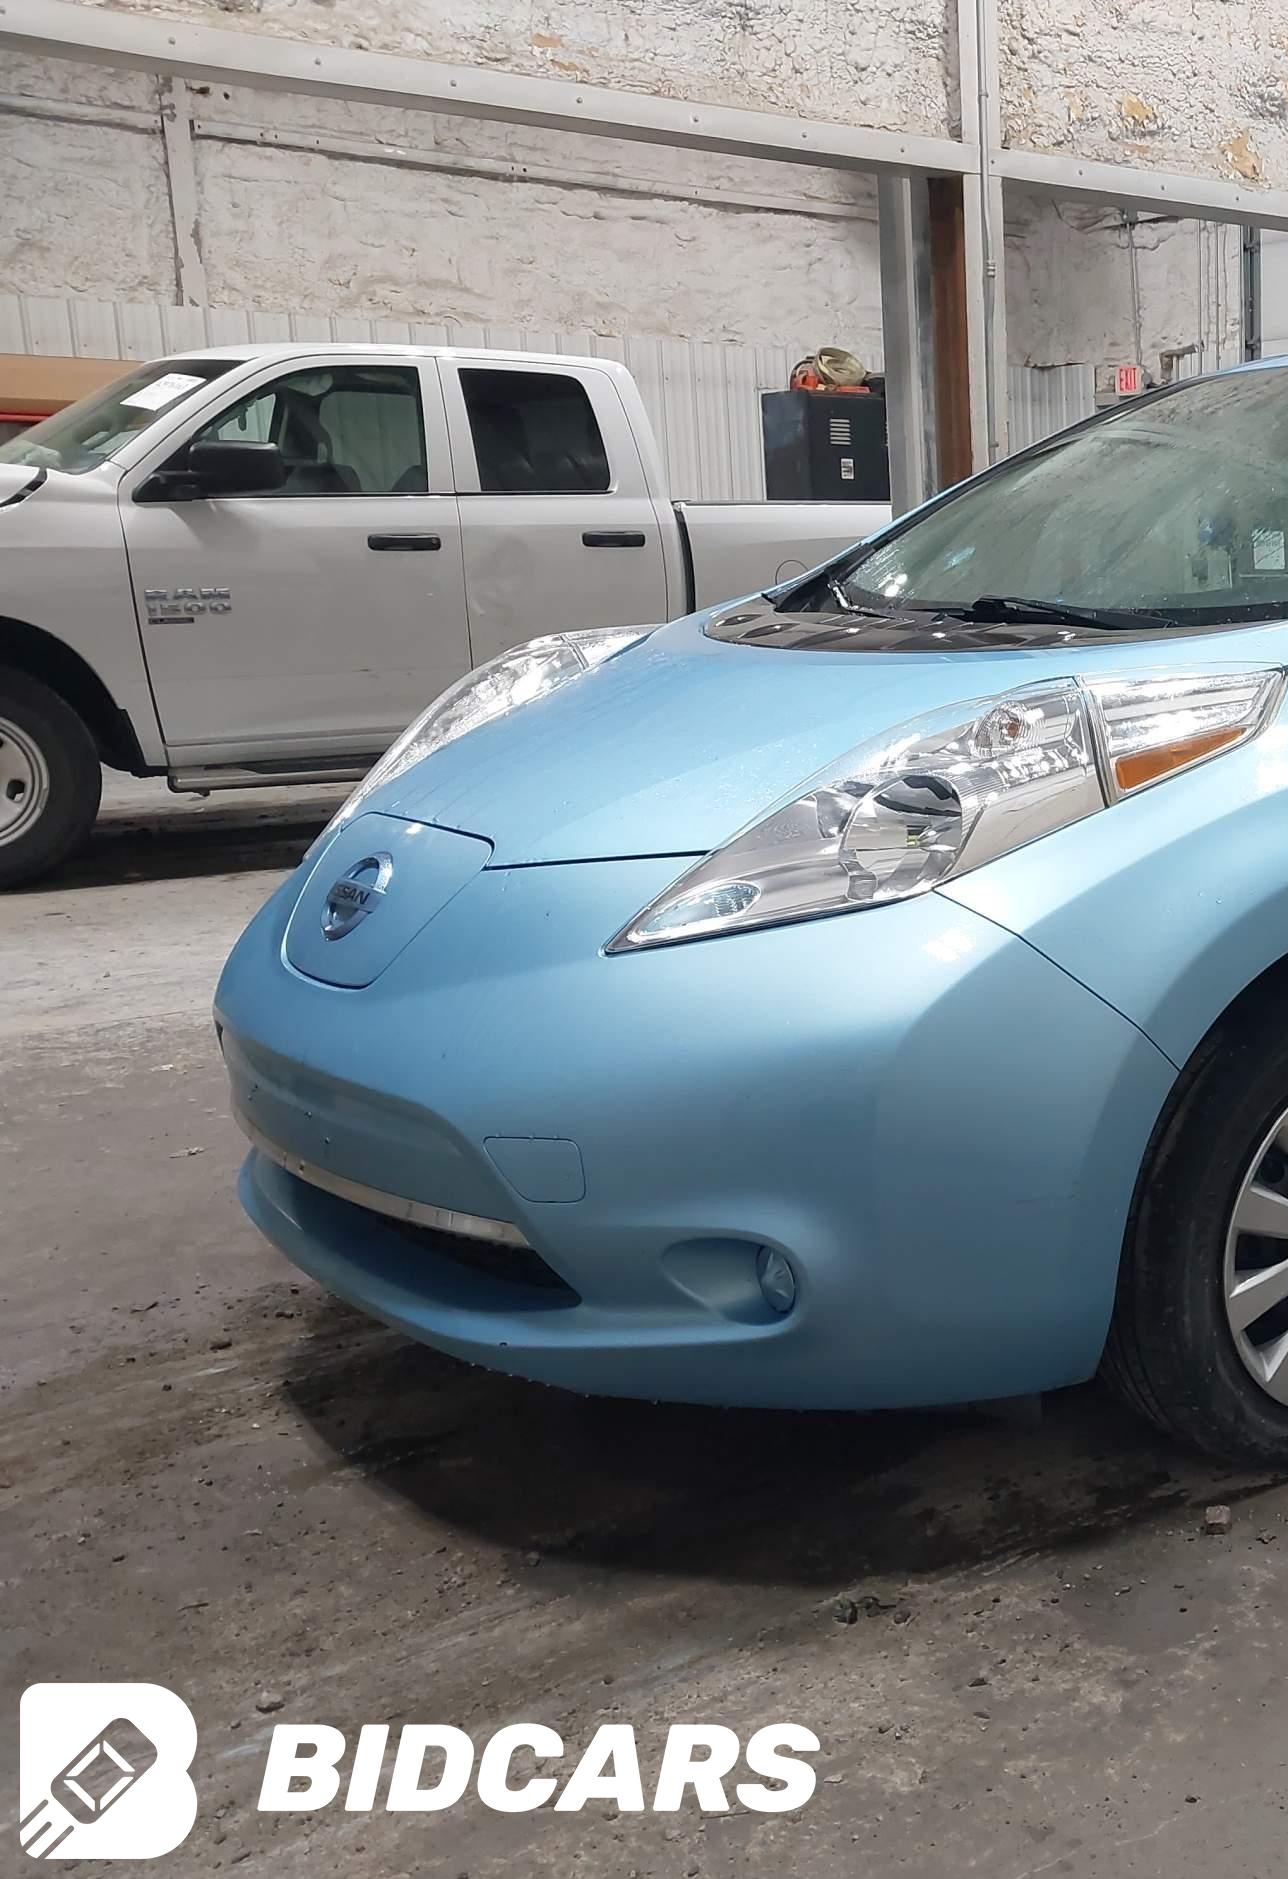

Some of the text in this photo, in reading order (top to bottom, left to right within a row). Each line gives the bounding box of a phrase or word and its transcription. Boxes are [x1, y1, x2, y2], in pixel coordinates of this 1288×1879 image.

[1119, 367, 1136, 391] EXIT
[144, 588, 230, 600] RAM
[146, 602, 232, 616] 1500
[331, 883, 370, 905] SSAN
